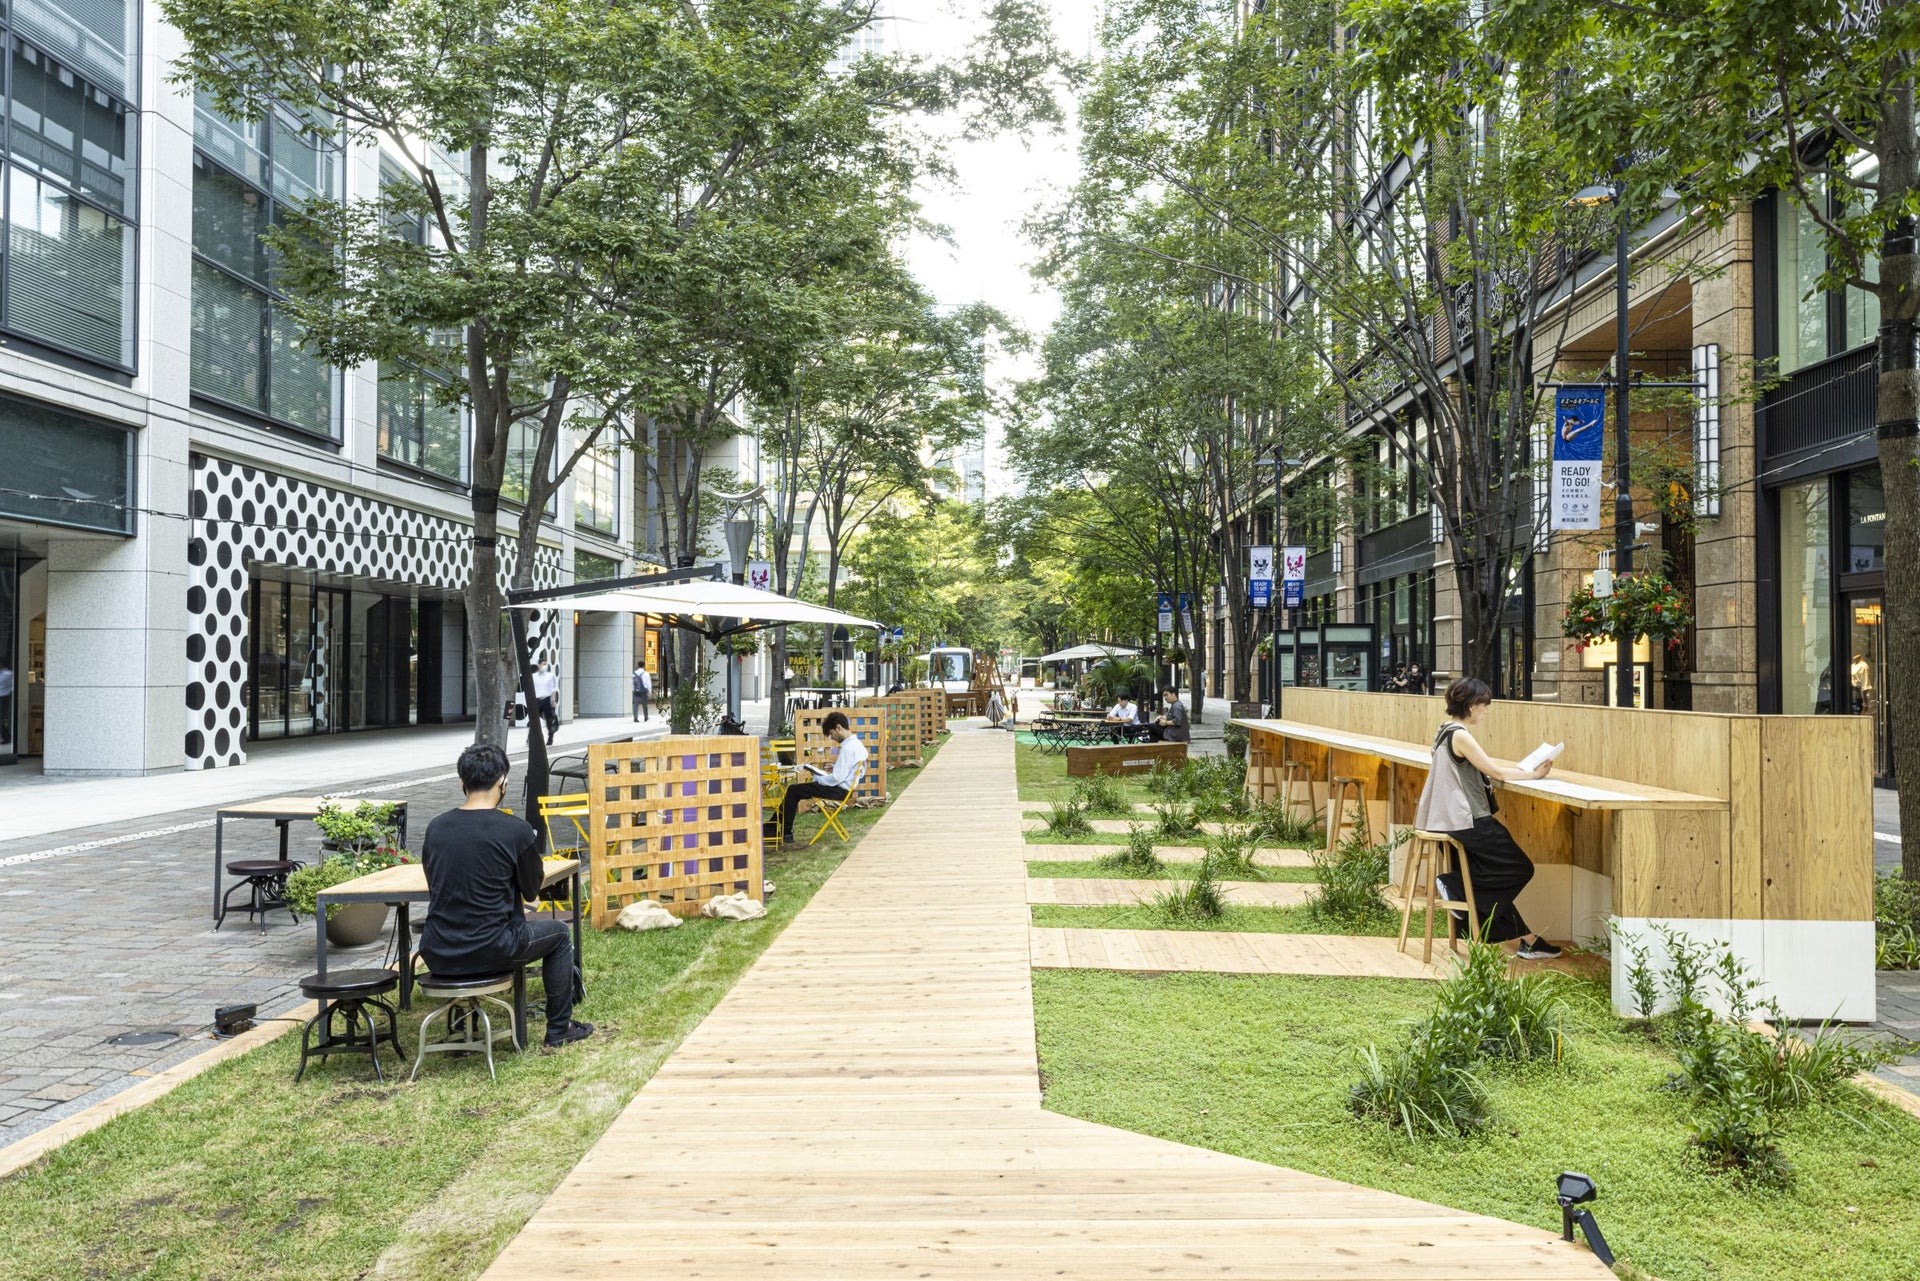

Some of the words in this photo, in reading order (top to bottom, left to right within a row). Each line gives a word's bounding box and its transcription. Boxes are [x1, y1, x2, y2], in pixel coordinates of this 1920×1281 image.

[1561, 467, 1591, 476] READY
[1561, 477, 1572, 487] TO
[1575, 477, 1590, 487] GO!
[1860, 516, 1867, 524] LA
